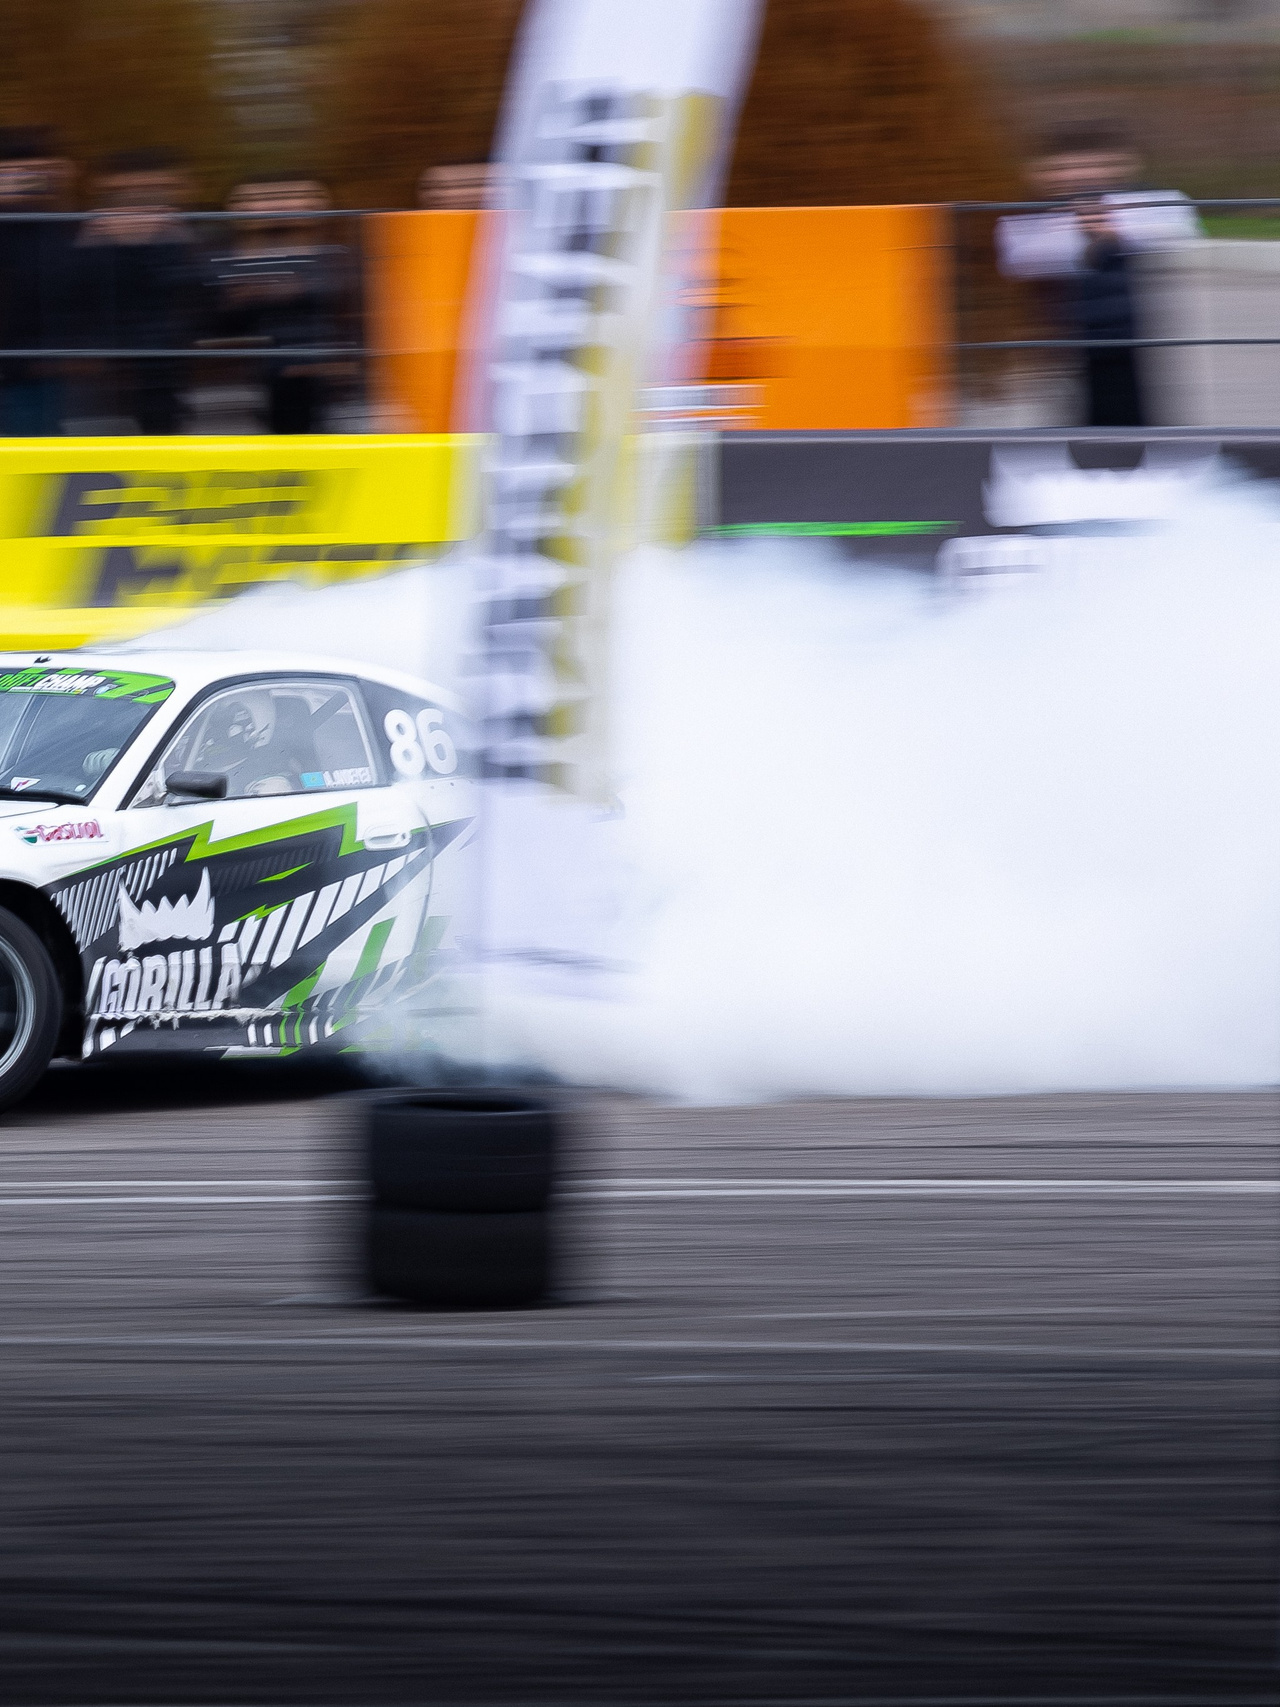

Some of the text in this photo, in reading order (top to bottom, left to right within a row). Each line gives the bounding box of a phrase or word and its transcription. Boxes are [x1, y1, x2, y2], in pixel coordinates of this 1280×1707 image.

[34, 674, 106, 690] CHAMP
[384, 708, 458, 776] 86
[96, 943, 243, 1014] GORILLA
